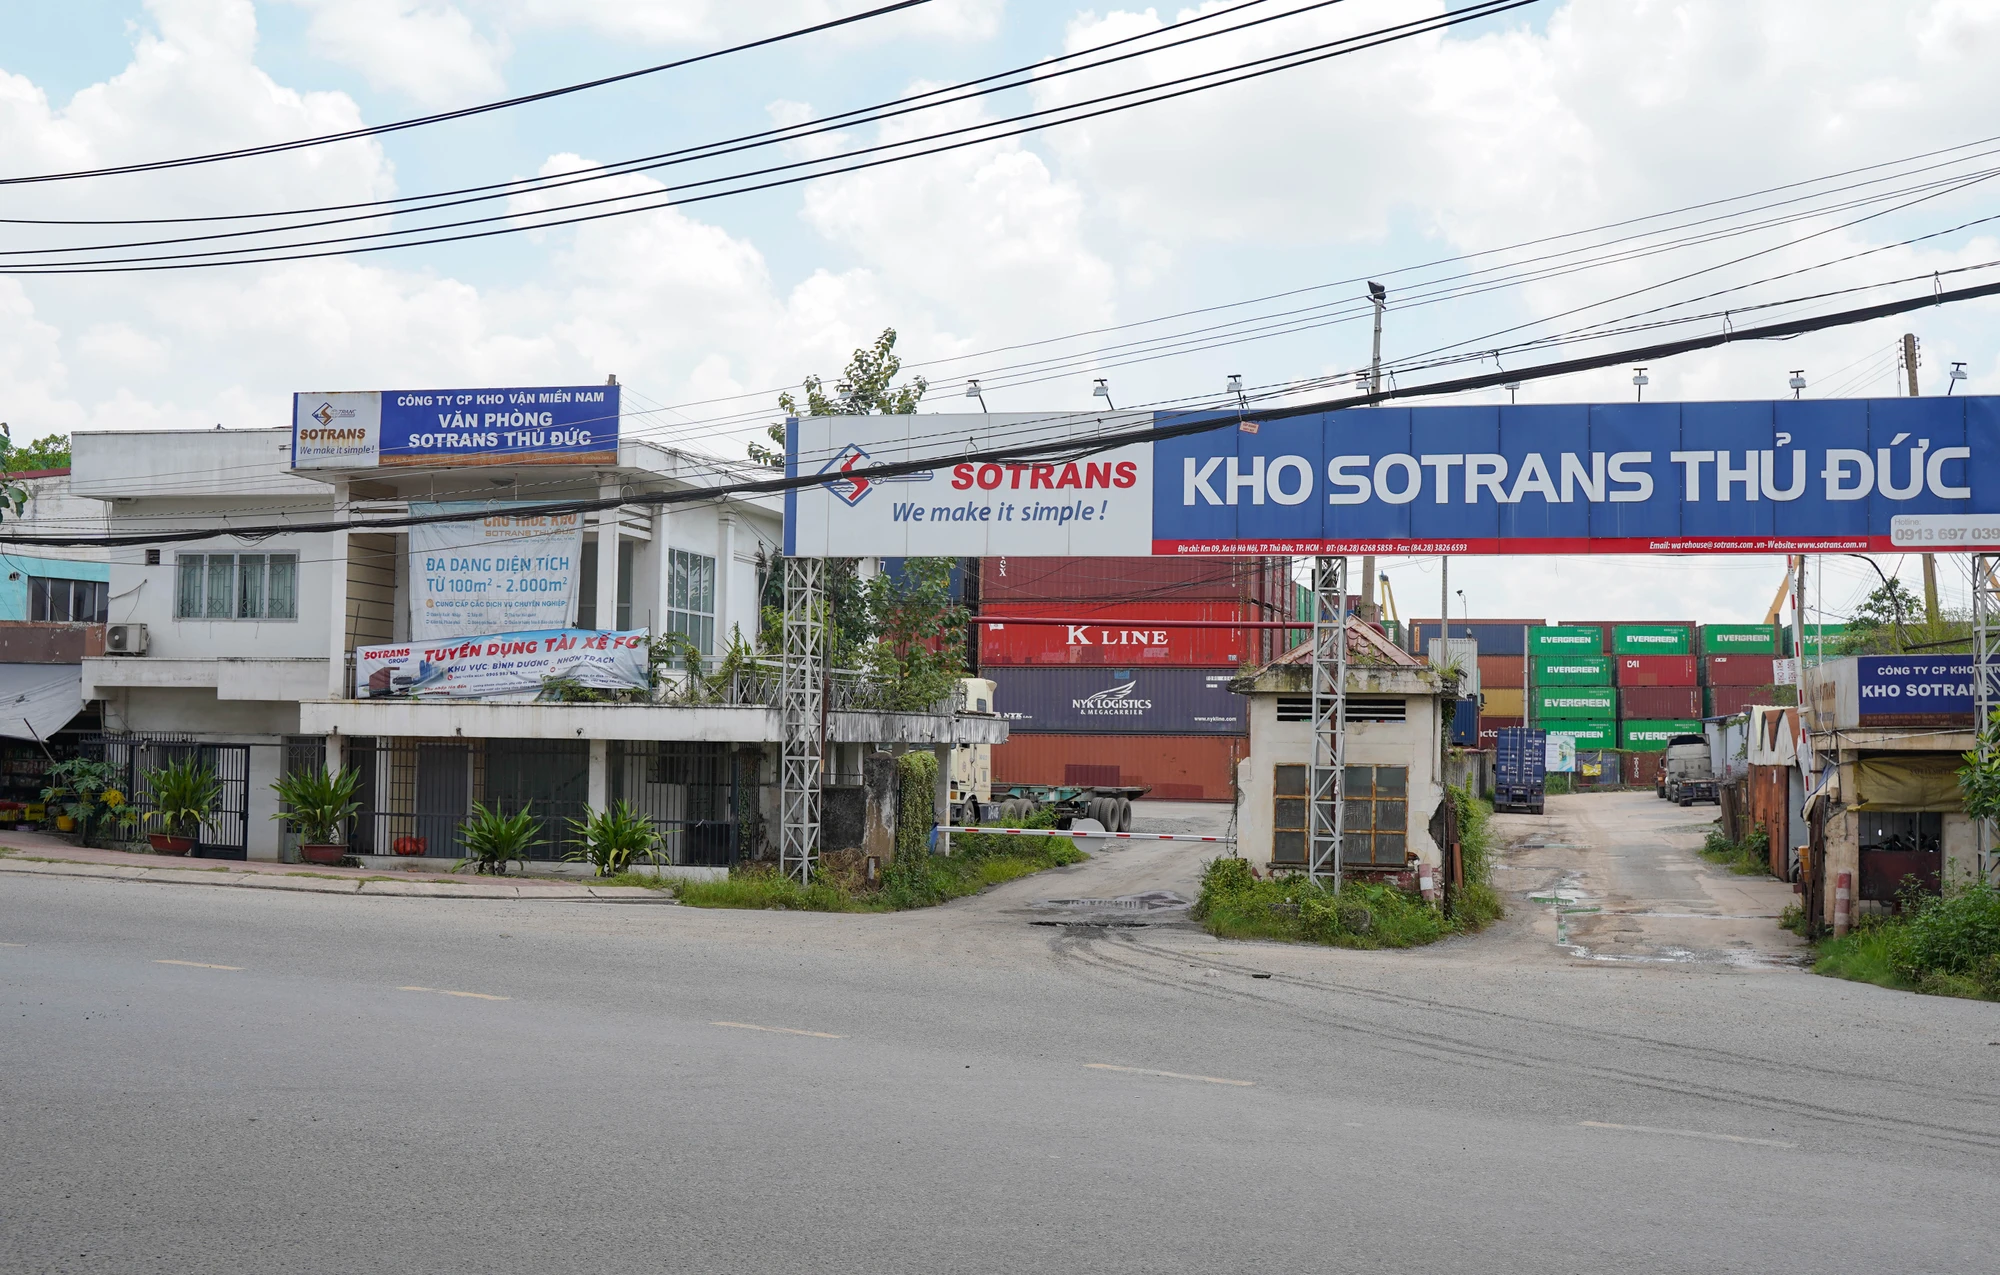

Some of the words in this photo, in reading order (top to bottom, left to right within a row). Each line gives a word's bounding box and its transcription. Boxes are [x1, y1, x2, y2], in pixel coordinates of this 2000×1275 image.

[397, 393, 433, 406] CÔNG
[436, 395, 452, 405] TY
[456, 395, 473, 405] CP
[476, 394, 504, 405] KHO
[509, 391, 536, 406] VẬN
[539, 388, 572, 404] MIỀN
[575, 391, 604, 402] NAM
[438, 410, 478, 428] VĂN
[484, 408, 553, 428] PHÒNG
[300, 428, 366, 440] SOTRANS
[408, 431, 498, 448] SOTRANS
[504, 427, 544, 446] THỦ
[550, 426, 592, 446] ĐỨC
[300, 446, 312, 454] We
[313, 446, 335, 455] make
[336, 446, 342, 454] it
[1184, 455, 1314, 507] KHO
[1328, 449, 1655, 506] SOTRANS
[1671, 432, 1807, 503] THỦ
[1821, 432, 1971, 500] ĐỨC
[951, 460, 1138, 491] SOTRANS
[892, 502, 925, 522] We
[930, 501, 992, 522] make
[997, 501, 1014, 522] it
[1894, 518, 1921, 526] Hotline:
[485, 529, 532, 537] SOTRANS
[1895, 528, 1934, 541] 0913
[1937, 527, 1968, 541] 697
[1971, 527, 2000, 540] 039
[1201, 544, 1210, 553] Km
[1221, 544, 1229, 553] Xa
[1237, 543, 1246, 553] Hà
[1259, 544, 1268, 552] TP.
[1269, 543, 1280, 552] Thủ
[1295, 544, 1305, 552] TP.
[1305, 544, 1319, 552] HCM
[1337, 543, 1359, 553] (84.28)
[1360, 543, 1376, 552] 6268
[1377, 543, 1393, 552] 5858
[1397, 543, 1410, 552] Fax:
[1410, 543, 1433, 553] (84.28)
[1434, 543, 1451, 552] 3826
[1451, 543, 1468, 552] 6593
[1649, 541, 1670, 550] Email:
[1797, 540, 1868, 549] www.sotrans.com.vn
[425, 557, 446, 572] ĐA
[450, 557, 492, 575] DẠNG
[495, 554, 531, 575] DIỆN
[535, 553, 570, 571] TÍCH
[426, 575, 446, 592] TỪ
[435, 600, 453, 608] CUNG
[486, 600, 502, 609] DỊCH
[1101, 630, 1169, 645] LINE
[1540, 636, 1592, 644] EVERGREEN
[1626, 635, 1678, 644] EVERGREEN
[1716, 634, 1770, 642] EVERGREEN
[424, 641, 483, 663] TUYỂN
[486, 640, 538, 659] DỤNG
[544, 632, 578, 653] TÀI
[580, 632, 612, 650] XẾ
[363, 648, 411, 660] SOTRANS
[388, 657, 409, 665] GROUP
[447, 664, 465, 673] KHU
[492, 660, 513, 670] BÌNH
[516, 659, 549, 668] DƯƠNG
[556, 654, 582, 665] NHƠN
[583, 654, 615, 665] TRẠCH
[1626, 660, 1640, 668] CAI
[1547, 666, 1600, 674] EVERGREEN
[1877, 664, 1909, 676] CÔNG
[1913, 666, 1928, 675] TY
[1931, 666, 1947, 675] CP
[1950, 665, 1974, 675] KHO
[1861, 684, 1901, 698] KHO
[1072, 699, 1095, 709] NYK
[1097, 699, 1152, 709] LOGISTICS
[1544, 698, 1610, 708] EVERGREEN
[1003, 712, 1023, 720] NYK
[1194, 715, 1237, 723] www.nykline.com
